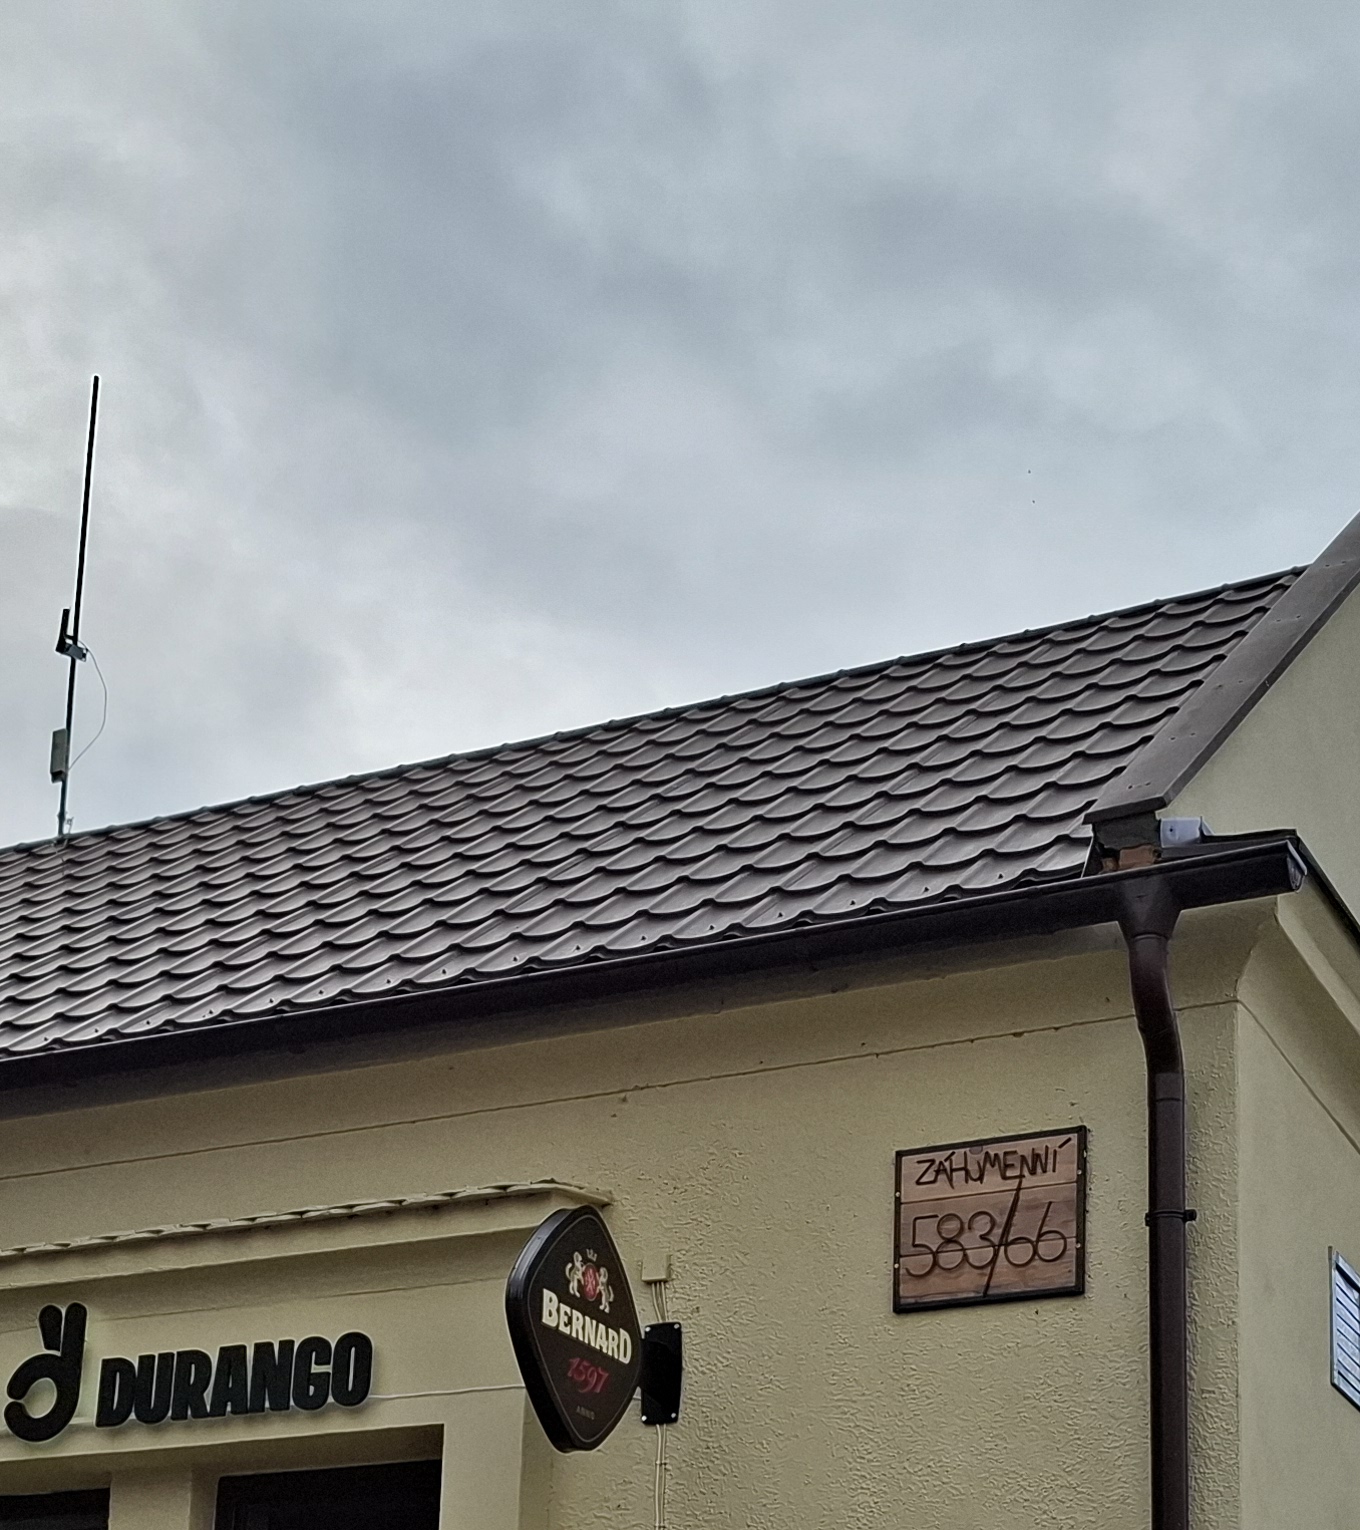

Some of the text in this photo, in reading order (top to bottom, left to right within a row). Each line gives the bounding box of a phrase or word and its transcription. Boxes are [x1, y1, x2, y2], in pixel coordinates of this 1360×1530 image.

[904, 1180, 1068, 1298] 583/66
[542, 1288, 632, 1365] BERNARD
[95, 1331, 373, 1428] DURANGO
